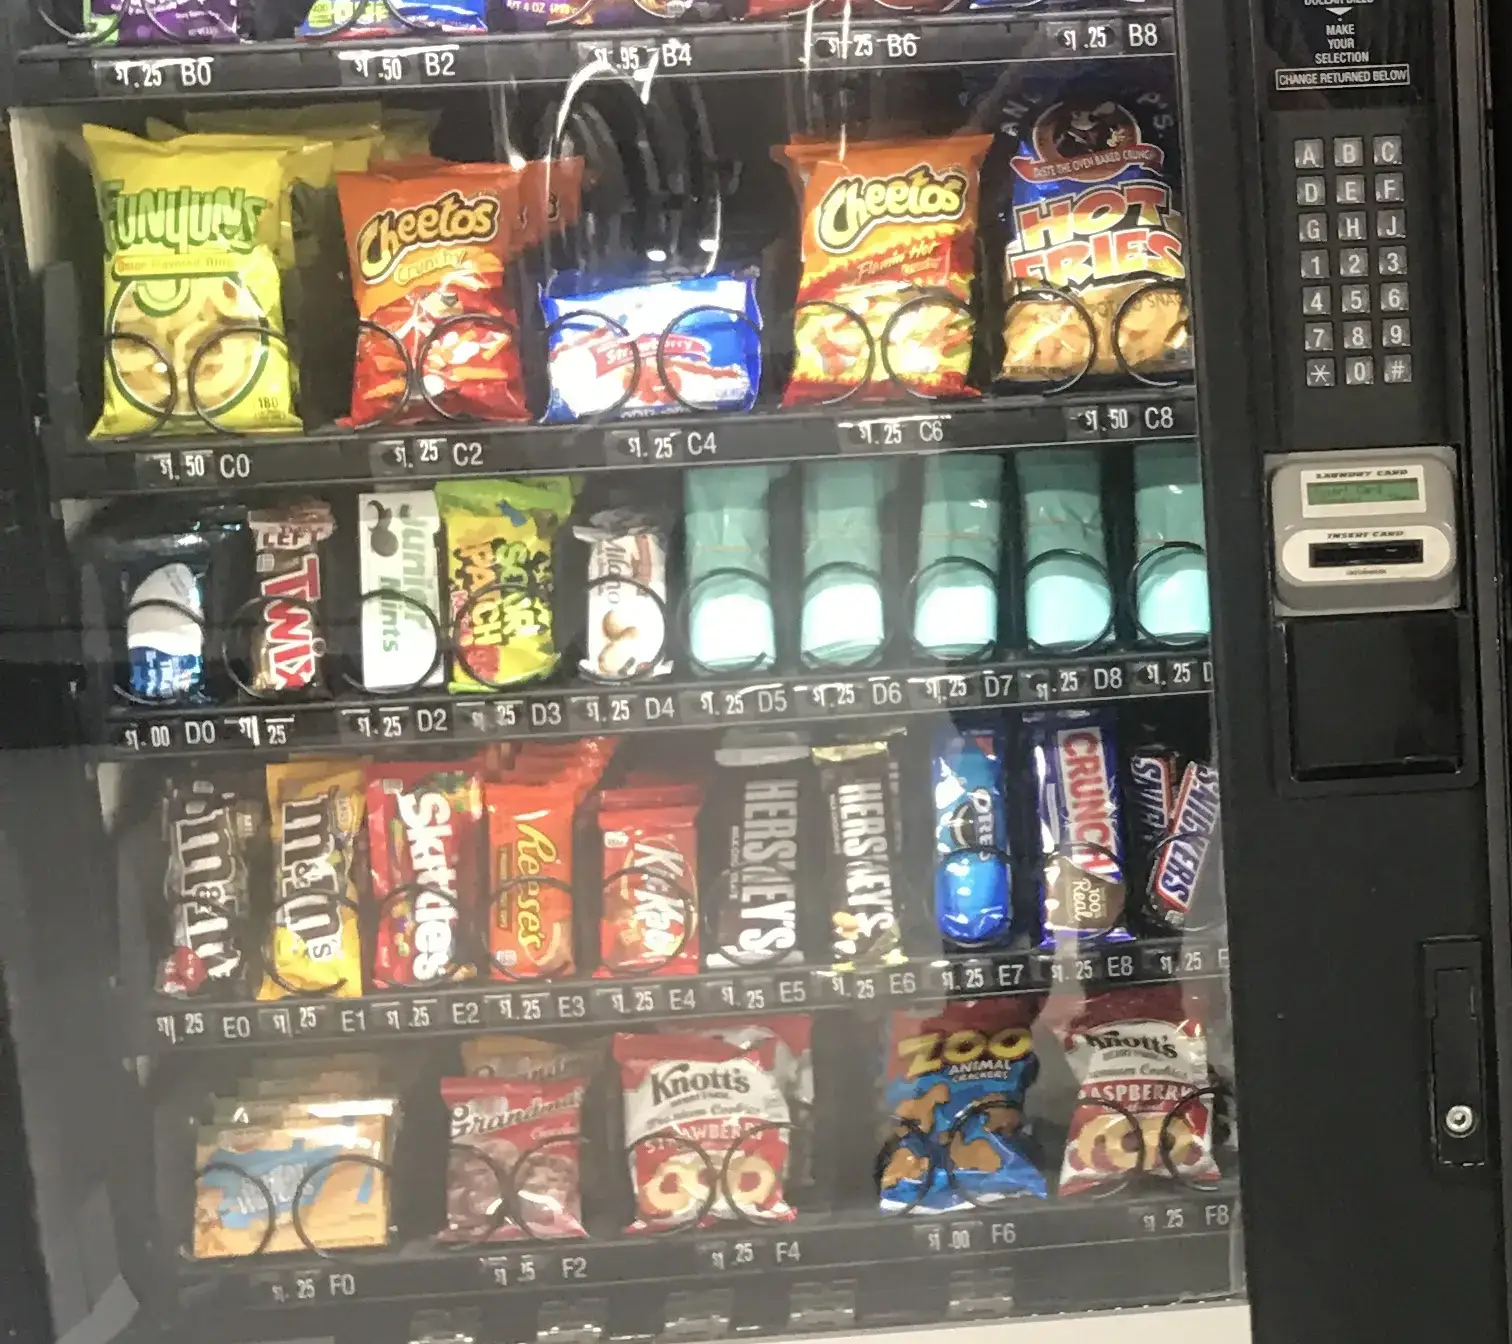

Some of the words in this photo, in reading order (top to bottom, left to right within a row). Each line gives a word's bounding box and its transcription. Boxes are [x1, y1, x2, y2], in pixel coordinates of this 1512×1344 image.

[1128, 23, 1159, 48] B8
[1325, 23, 1355, 36] MAKE
[888, 33, 918, 58] B6
[1327, 37, 1355, 49] YOUR
[424, 52, 457, 77] B2
[662, 42, 693, 68] B4
[1314, 51, 1369, 64] SELECTION
[181, 61, 212, 86] B0
[1279, 72, 1318, 85] CHANGE
[1320, 71, 1371, 84] RETURNED
[1372, 69, 1408, 82] BELOW
[1303, 146, 1317, 165] A
[1343, 144, 1356, 163] B
[1381, 142, 1394, 162] C
[1305, 183, 1318, 202] D
[1346, 182, 1357, 201] E
[1383, 179, 1395, 199] F
[819, 166, 967, 252] Cheetos
[1017, 182, 1171, 251] HOT
[358, 191, 499, 283] Cheetos
[1307, 220, 1320, 239] G
[1347, 218, 1360, 237] H
[1386, 216, 1397, 236] J
[1007, 230, 1186, 292] FRIES
[1311, 256, 1320, 275] 1
[1349, 255, 1361, 274] 2
[1387, 253, 1399, 272] 3
[1311, 292, 1323, 311] 4
[1350, 291, 1362, 309] 5
[1388, 288, 1400, 308] 6
[1313, 329, 1325, 347] 7
[1352, 327, 1364, 346] 8
[1390, 325, 1402, 344] 9
[1144, 406, 1174, 430] C8
[919, 420, 944, 443] C6
[453, 441, 484, 467] C2
[687, 431, 718, 456] C4
[220, 453, 251, 478] C0
[1316, 470, 1372, 479] LAUNDRY
[1376, 469, 1408, 477] CARD
[1327, 531, 1369, 539] INSERT
[1372, 530, 1404, 538] CARD
[261, 553, 326, 690] TWIX
[985, 674, 1013, 698] D7
[1094, 667, 1123, 691] D8
[758, 690, 788, 713] D5
[873, 682, 902, 704] D6
[532, 703, 562, 726] D3
[645, 697, 675, 720] D4
[185, 719, 216, 745] D0
[417, 709, 448, 732] D2
[1063, 732, 1120, 873] CRUNCH
[516, 822, 558, 953] Reese's
[998, 964, 1025, 986] E7
[1108, 955, 1133, 977] E8
[780, 981, 806, 1003] E5
[889, 972, 916, 995] E6
[558, 995, 585, 1018] E3
[669, 988, 697, 1011] E4
[342, 1009, 365, 1032] E1
[453, 1002, 480, 1026] E2
[223, 1015, 250, 1039] E0
[897, 1028, 1034, 1080] ZOO
[1085, 1029, 1179, 1059] Knott's
[948, 1060, 1012, 1076] ANIMAL
[650, 1063, 751, 1105] Knott's
[1204, 1204, 1230, 1226] F8
[991, 1222, 1016, 1244] F6
[775, 1241, 801, 1263] F4
[562, 1256, 588, 1279] F2
[329, 1273, 356, 1296] F0
